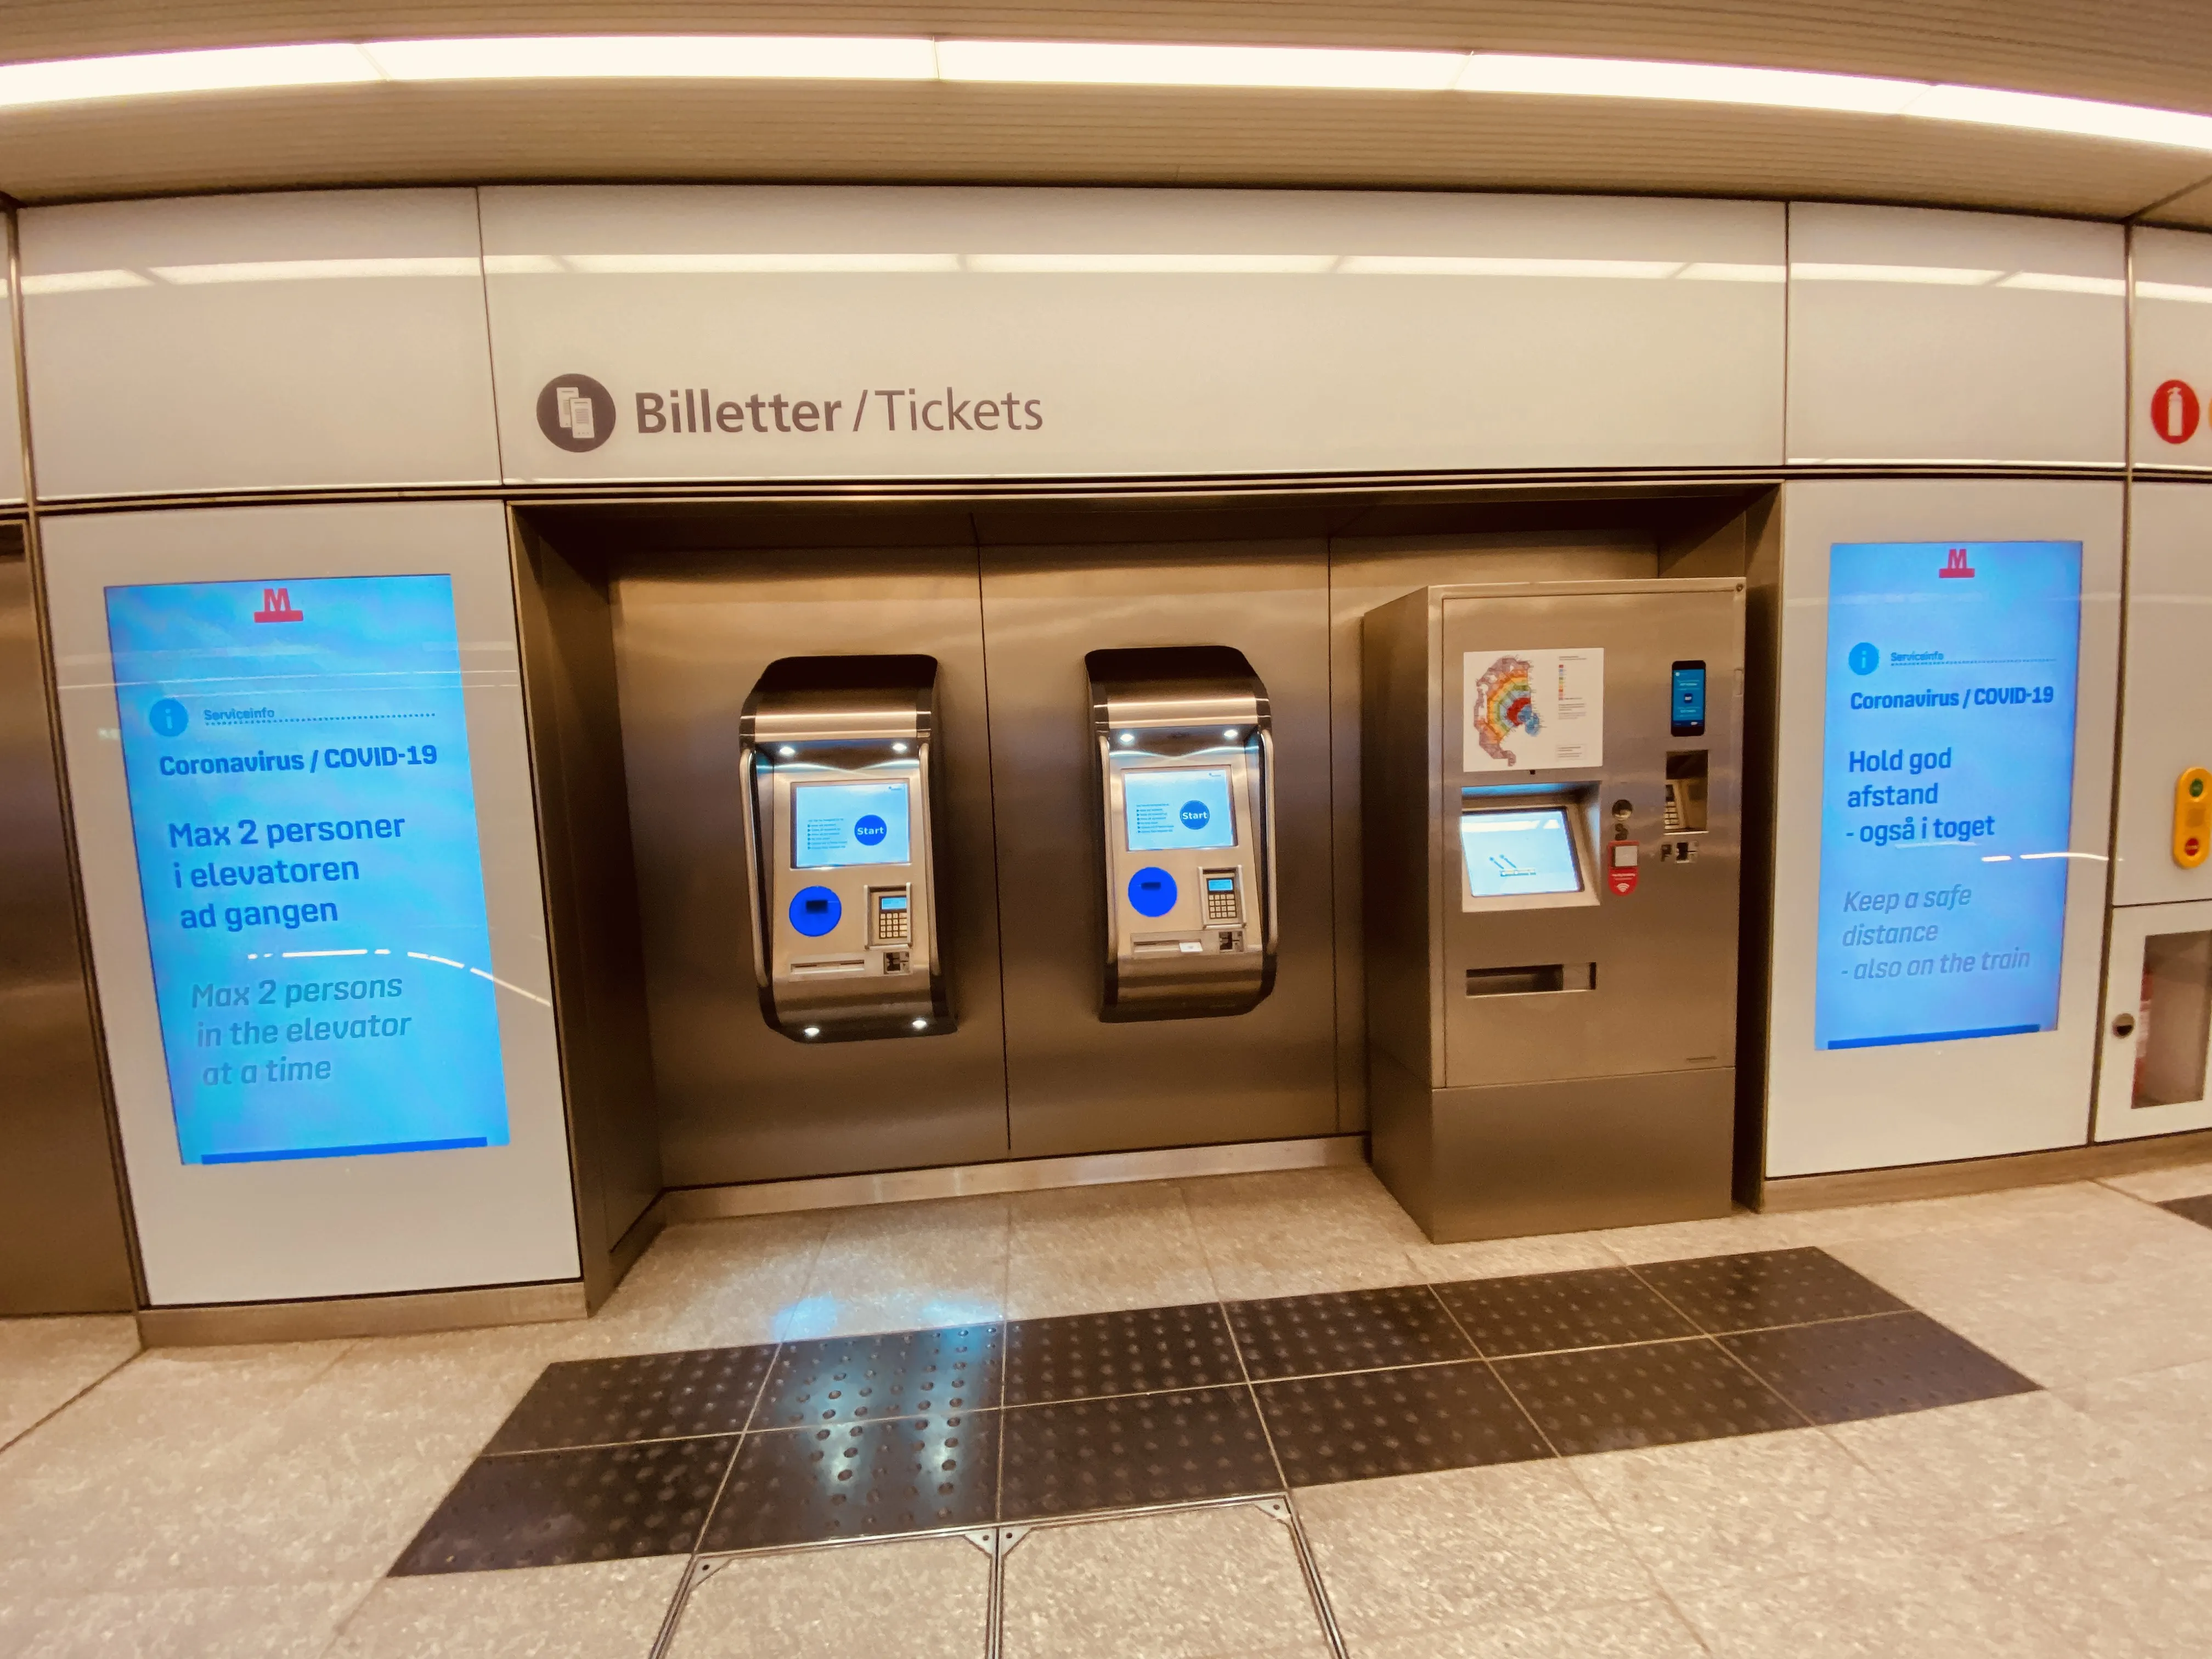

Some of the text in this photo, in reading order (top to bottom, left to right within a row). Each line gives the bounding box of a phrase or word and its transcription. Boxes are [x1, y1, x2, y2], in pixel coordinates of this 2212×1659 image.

[635, 388, 842, 433] Billetter
[875, 387, 1043, 431] Tickets
[1850, 689, 1960, 709] Coronavirus
[1974, 686, 2054, 706] COVID-19
[204, 707, 275, 721] Serviceinfo
[159, 750, 304, 776] Coronavirus
[324, 745, 437, 769] COVID-19
[1849, 747, 1952, 775] Hold god
[1847, 783, 1939, 808] afstand
[857, 826, 884, 835] Start
[1182, 811, 1207, 820] Start
[169, 818, 405, 849] Max 2 personer
[1859, 817, 1915, 846] også
[1921, 816, 1928, 839] i
[1933, 816, 1995, 842] toget
[173, 860, 359, 889] i elevatoren
[1843, 884, 1972, 915] Keep a safe
[180, 901, 338, 932] ad gangen
[1842, 923, 1938, 947] distance
[1853, 958, 1901, 980] also
[1907, 959, 1934, 976] on
[1940, 952, 1976, 973] the
[1980, 947, 2030, 971] train
[191, 977, 403, 1008] Max 2 persons
[198, 1014, 412, 1047] in the elevator
[202, 1056, 331, 1086] at a time
